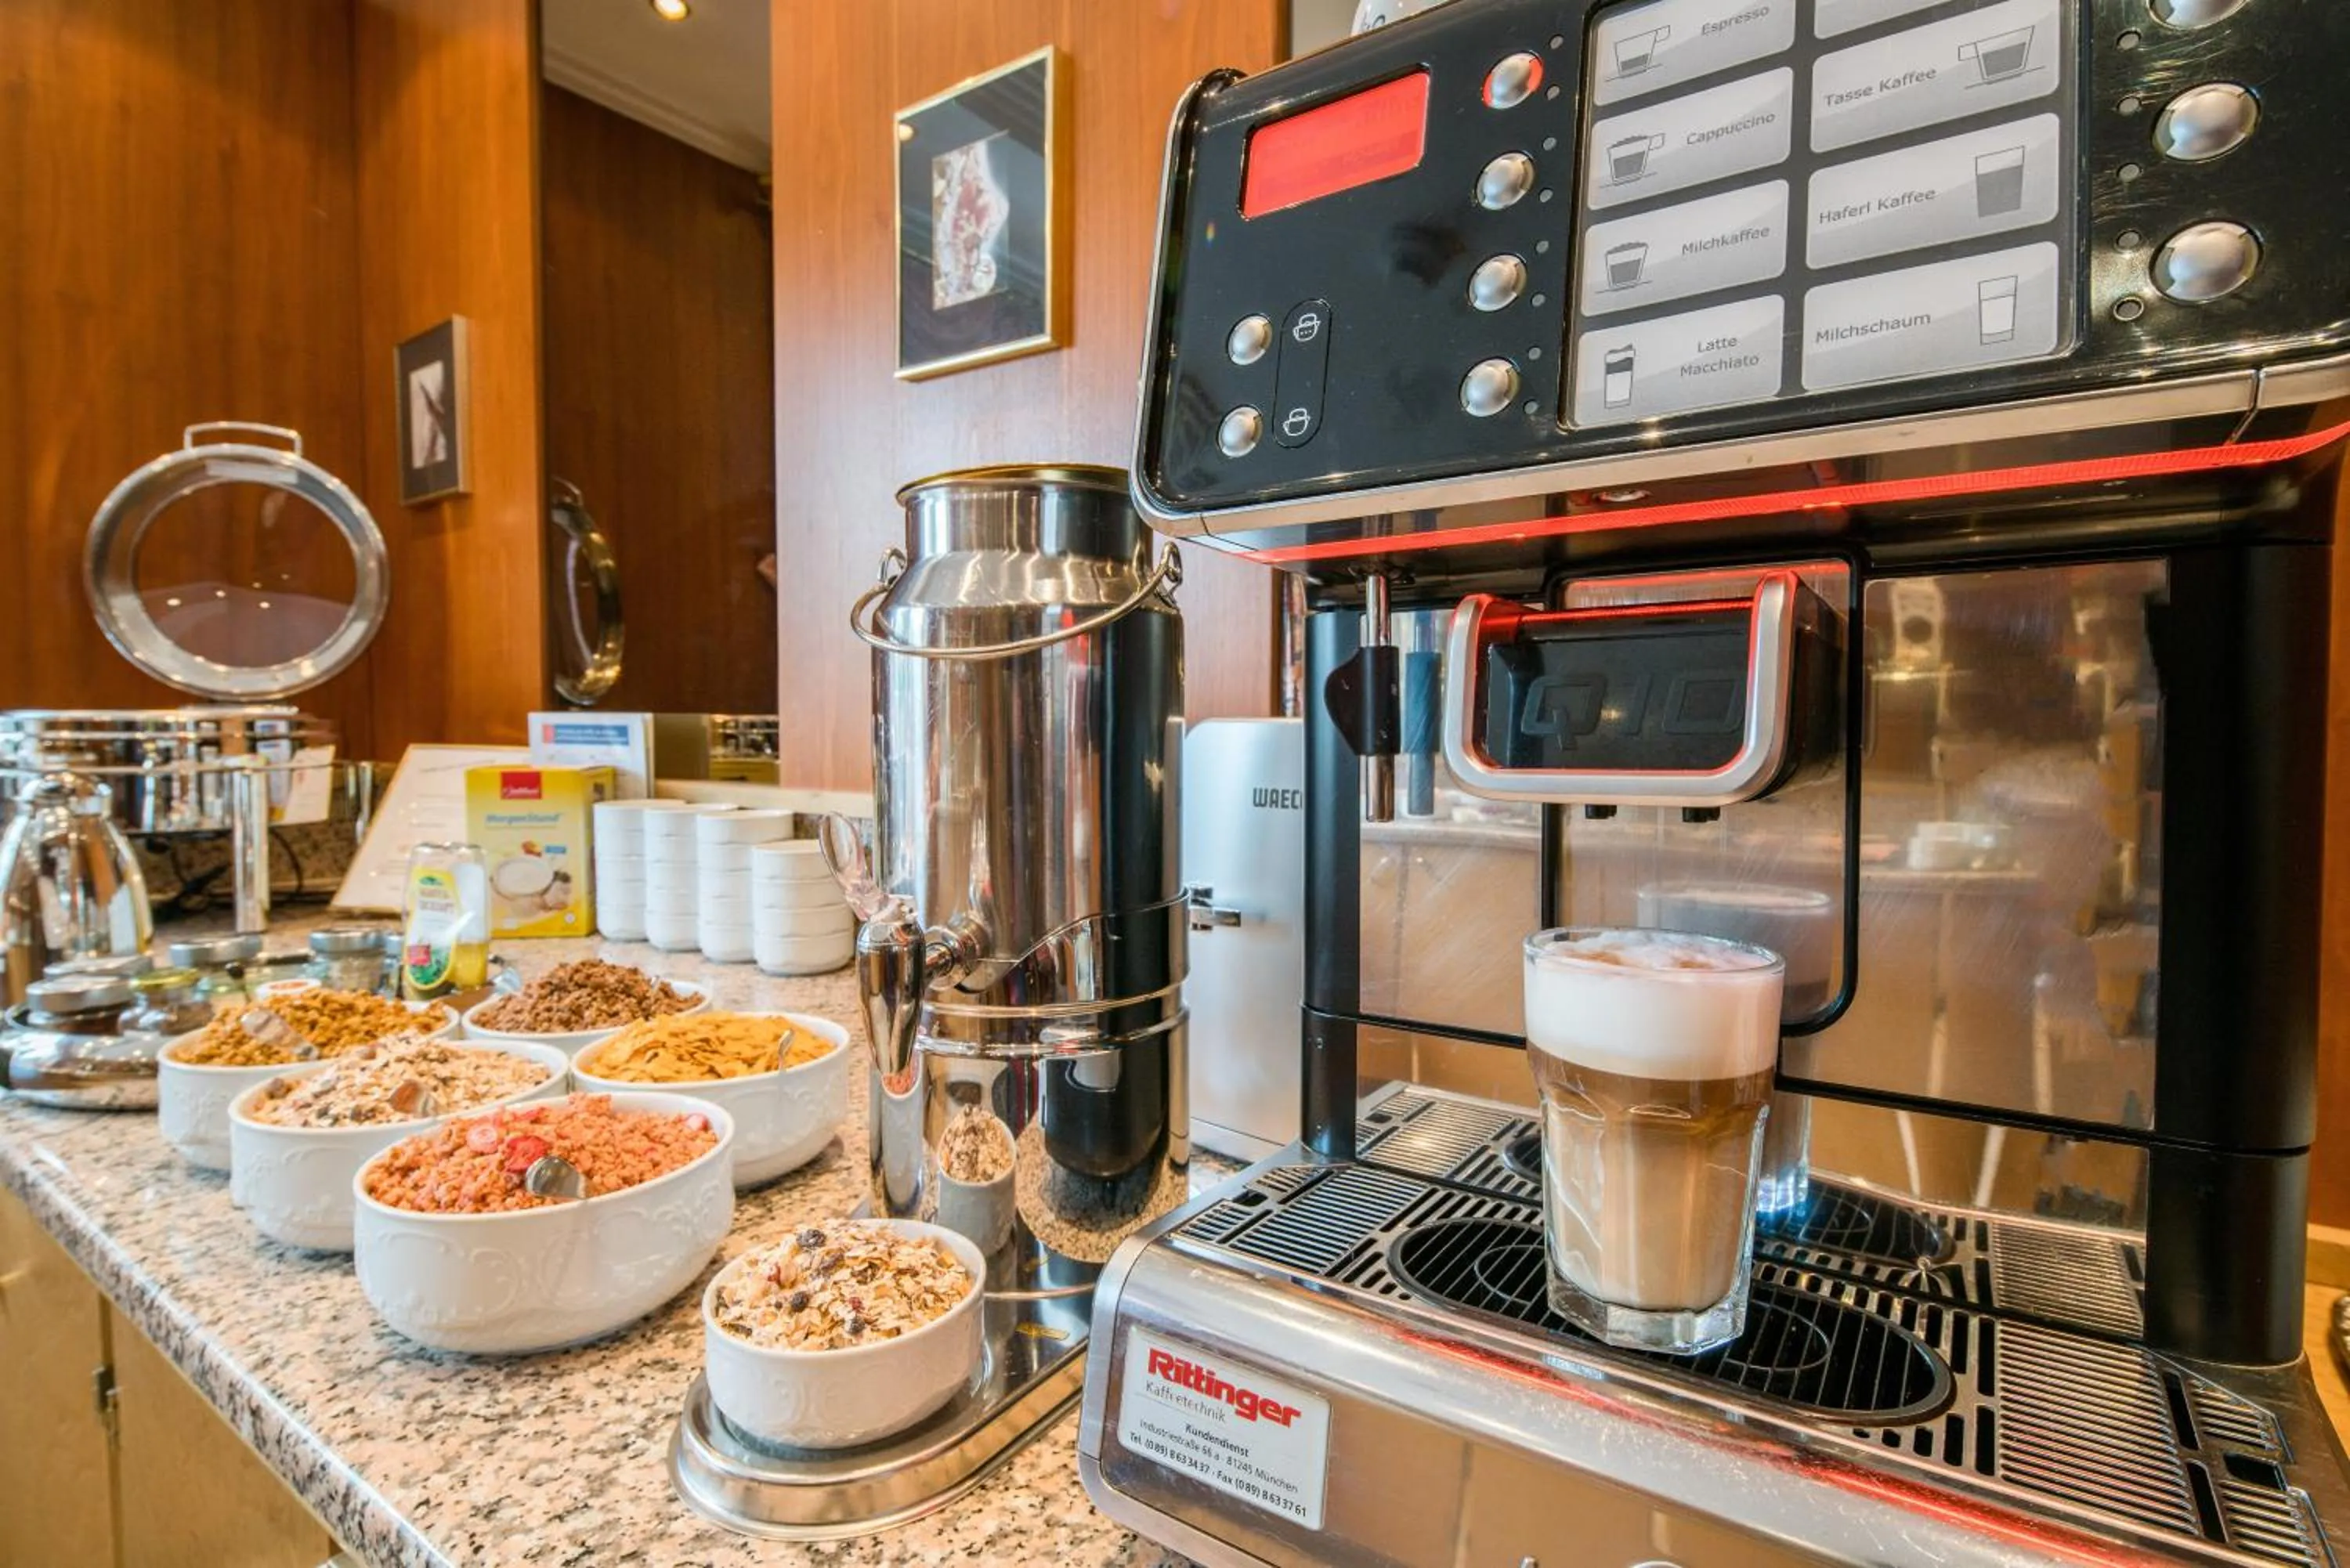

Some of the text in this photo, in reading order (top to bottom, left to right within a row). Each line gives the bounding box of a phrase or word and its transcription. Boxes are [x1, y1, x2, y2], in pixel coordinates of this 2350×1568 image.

[1700, 5, 1770, 36] Espresso
[1823, 67, 1938, 107] Tasse Kaffee
[1686, 112, 1777, 146] Cappuccino
[1818, 188, 1938, 225] Haferl Kaffee
[1681, 226, 1771, 256] Milchkaffee
[1697, 336, 1738, 353] Latte
[1814, 312, 1932, 344] Milchschaum
[1679, 355, 1760, 378] Macchiato
[1520, 671, 1744, 750] Q10
[1144, 1379, 1227, 1424] Kaffeetechnik
[1147, 1346, 1302, 1429] Rittinger
[1184, 1422, 1249, 1458] Kundendienst
[1217, 1469, 1233, 1485] Fax
[1254, 1467, 1299, 1494] München
